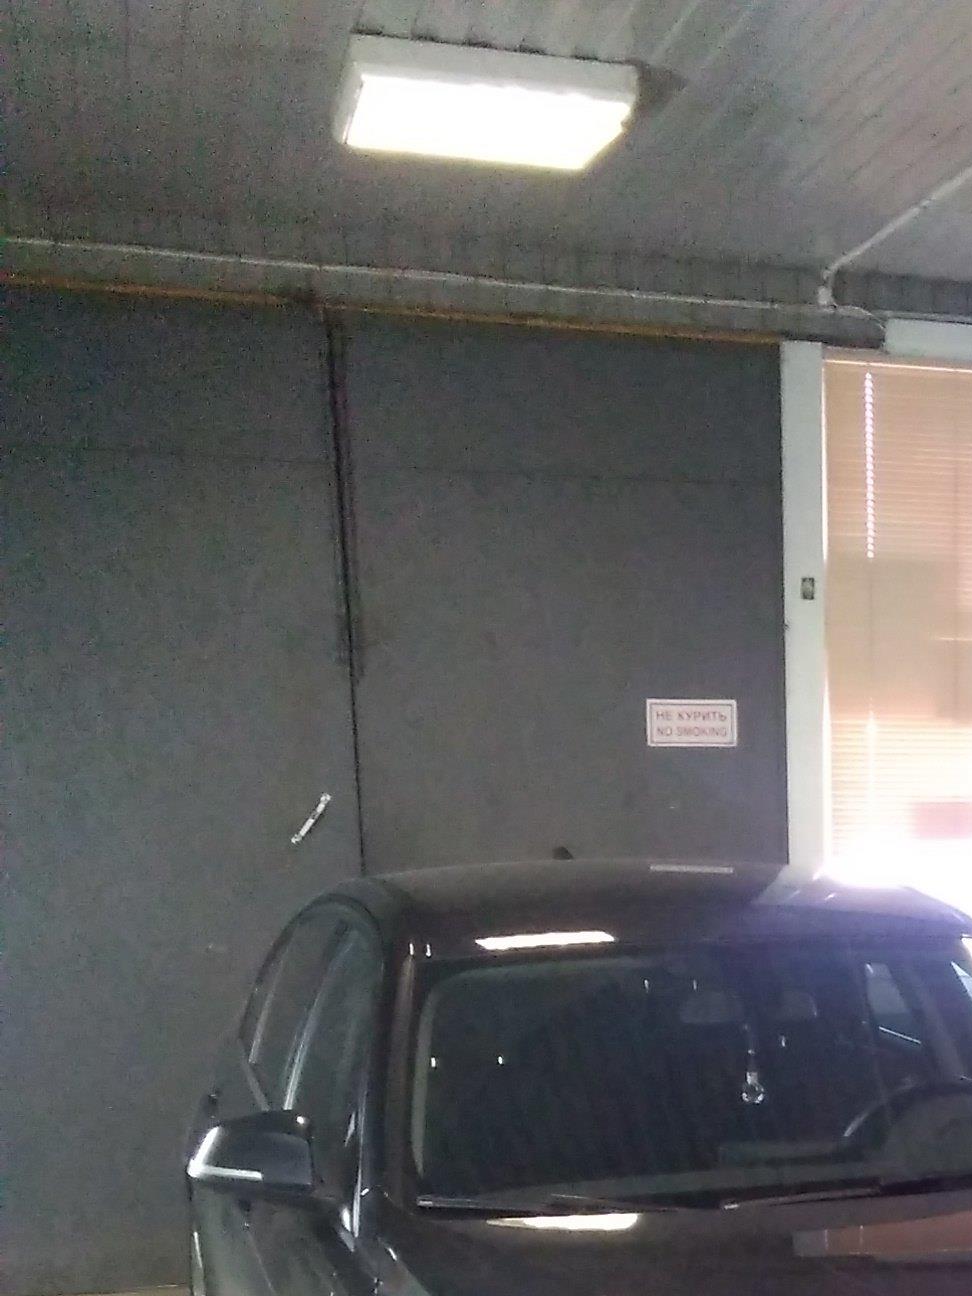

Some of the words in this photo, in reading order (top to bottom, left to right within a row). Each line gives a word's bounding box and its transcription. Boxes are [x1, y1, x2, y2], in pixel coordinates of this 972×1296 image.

[655, 710, 673, 721] НЕ
[676, 710, 728, 722] КУРИТЬ
[656, 727, 673, 737] NO
[676, 727, 728, 738] SMOKING
